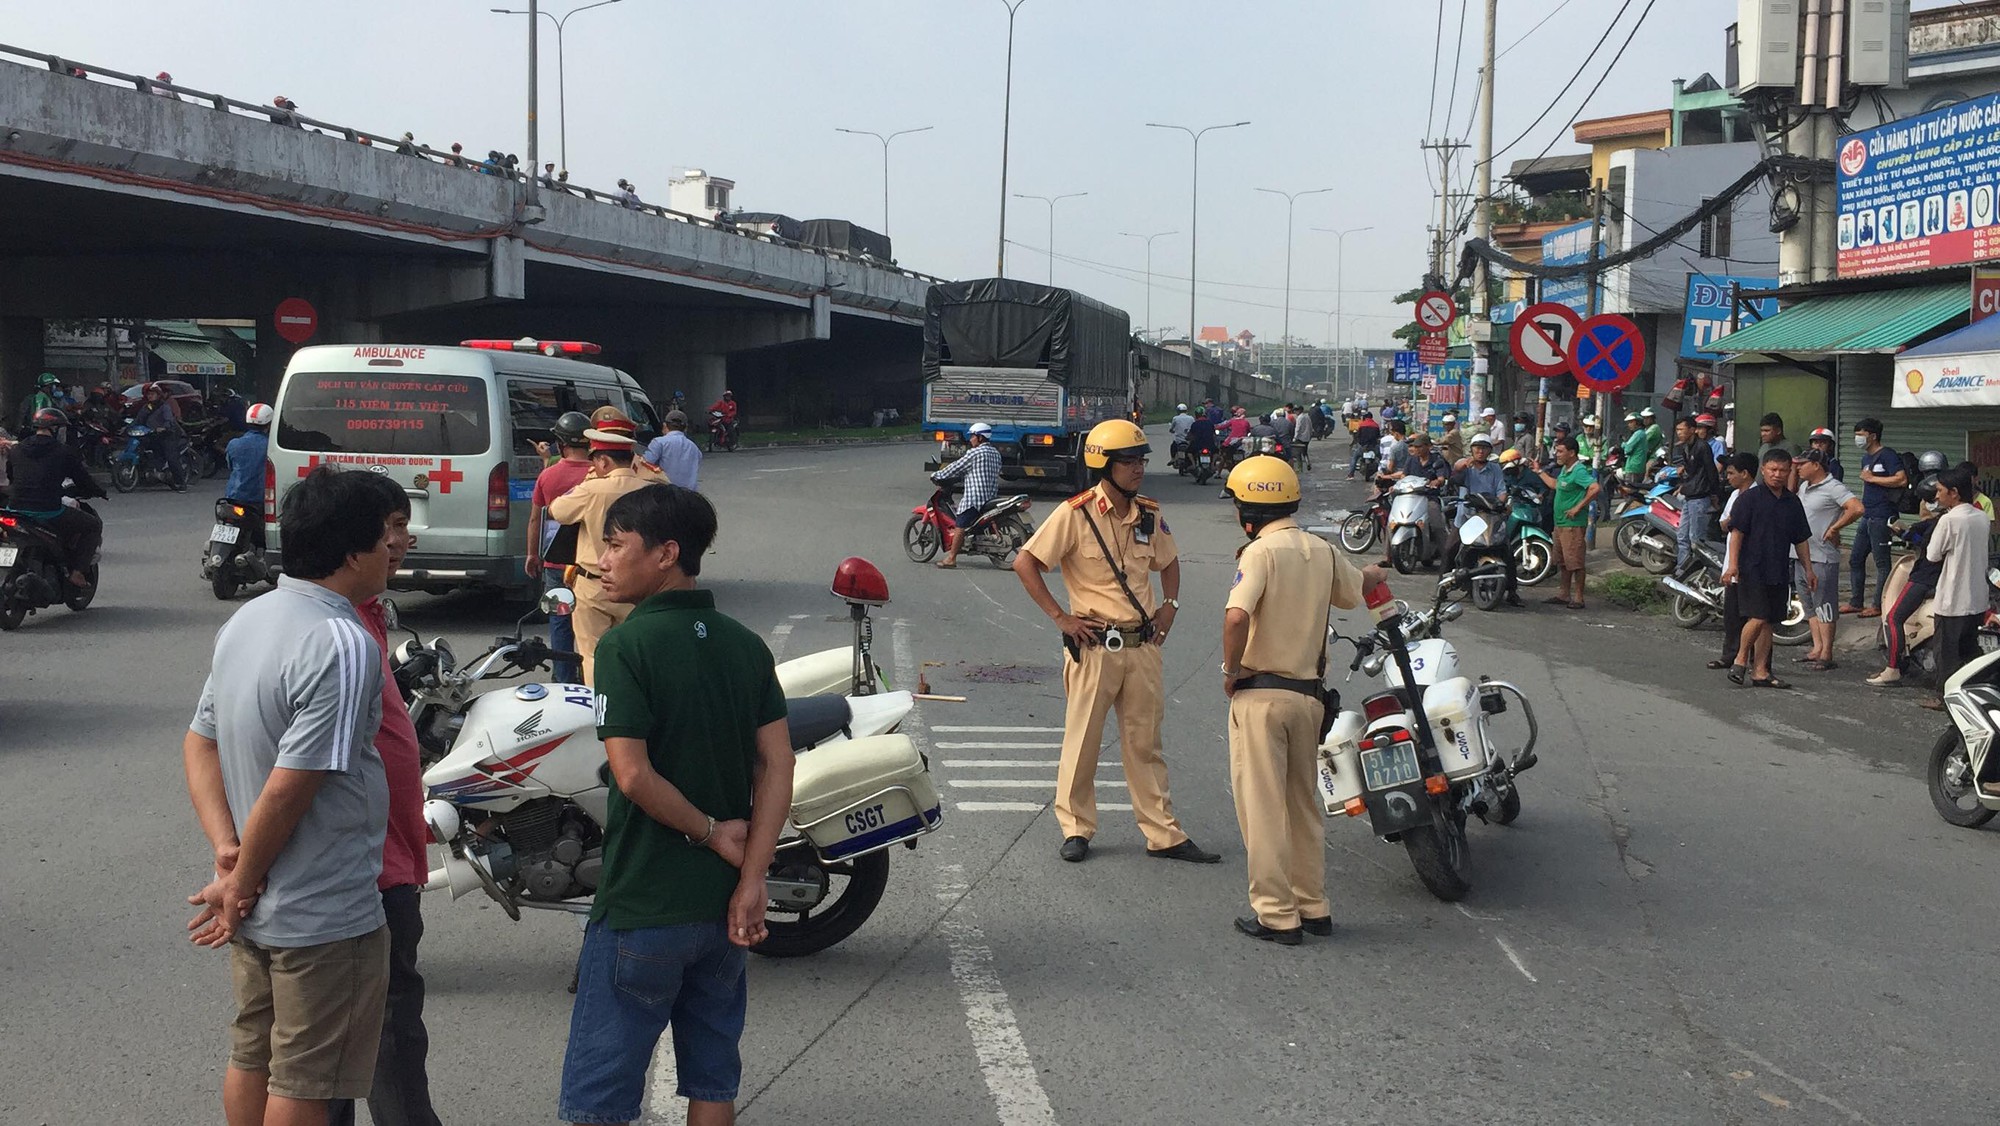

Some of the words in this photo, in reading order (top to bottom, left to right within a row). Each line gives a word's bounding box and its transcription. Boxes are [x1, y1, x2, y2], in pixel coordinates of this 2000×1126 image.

[1886, 128, 1908, 151] HÀNG
[1910, 122, 1927, 150] VẬT
[1940, 109, 1958, 138] CẤP
[1959, 105, 1982, 133] NƯỚC
[1876, 153, 1912, 170] CHUYÊN
[1914, 146, 1940, 160] CUNG
[1958, 152, 1974, 162] VAN
[354, 348, 426, 360] AMBULANCE
[1942, 367, 1960, 376] Shell
[1933, 375, 1986, 389] ADVANCE
[336, 399, 356, 408] 115
[347, 420, 424, 429] 0906739115
[1085, 444, 1103, 454] SGT
[1248, 482, 1284, 492] CSGT
[1414, 658, 1424, 670] 3
[564, 686, 593, 709] A5
[517, 728, 552, 743] HONDA
[1456, 732, 1469, 760] CSGT
[1321, 768, 1334, 795] CSGT
[845, 804, 885, 834] CSGT
